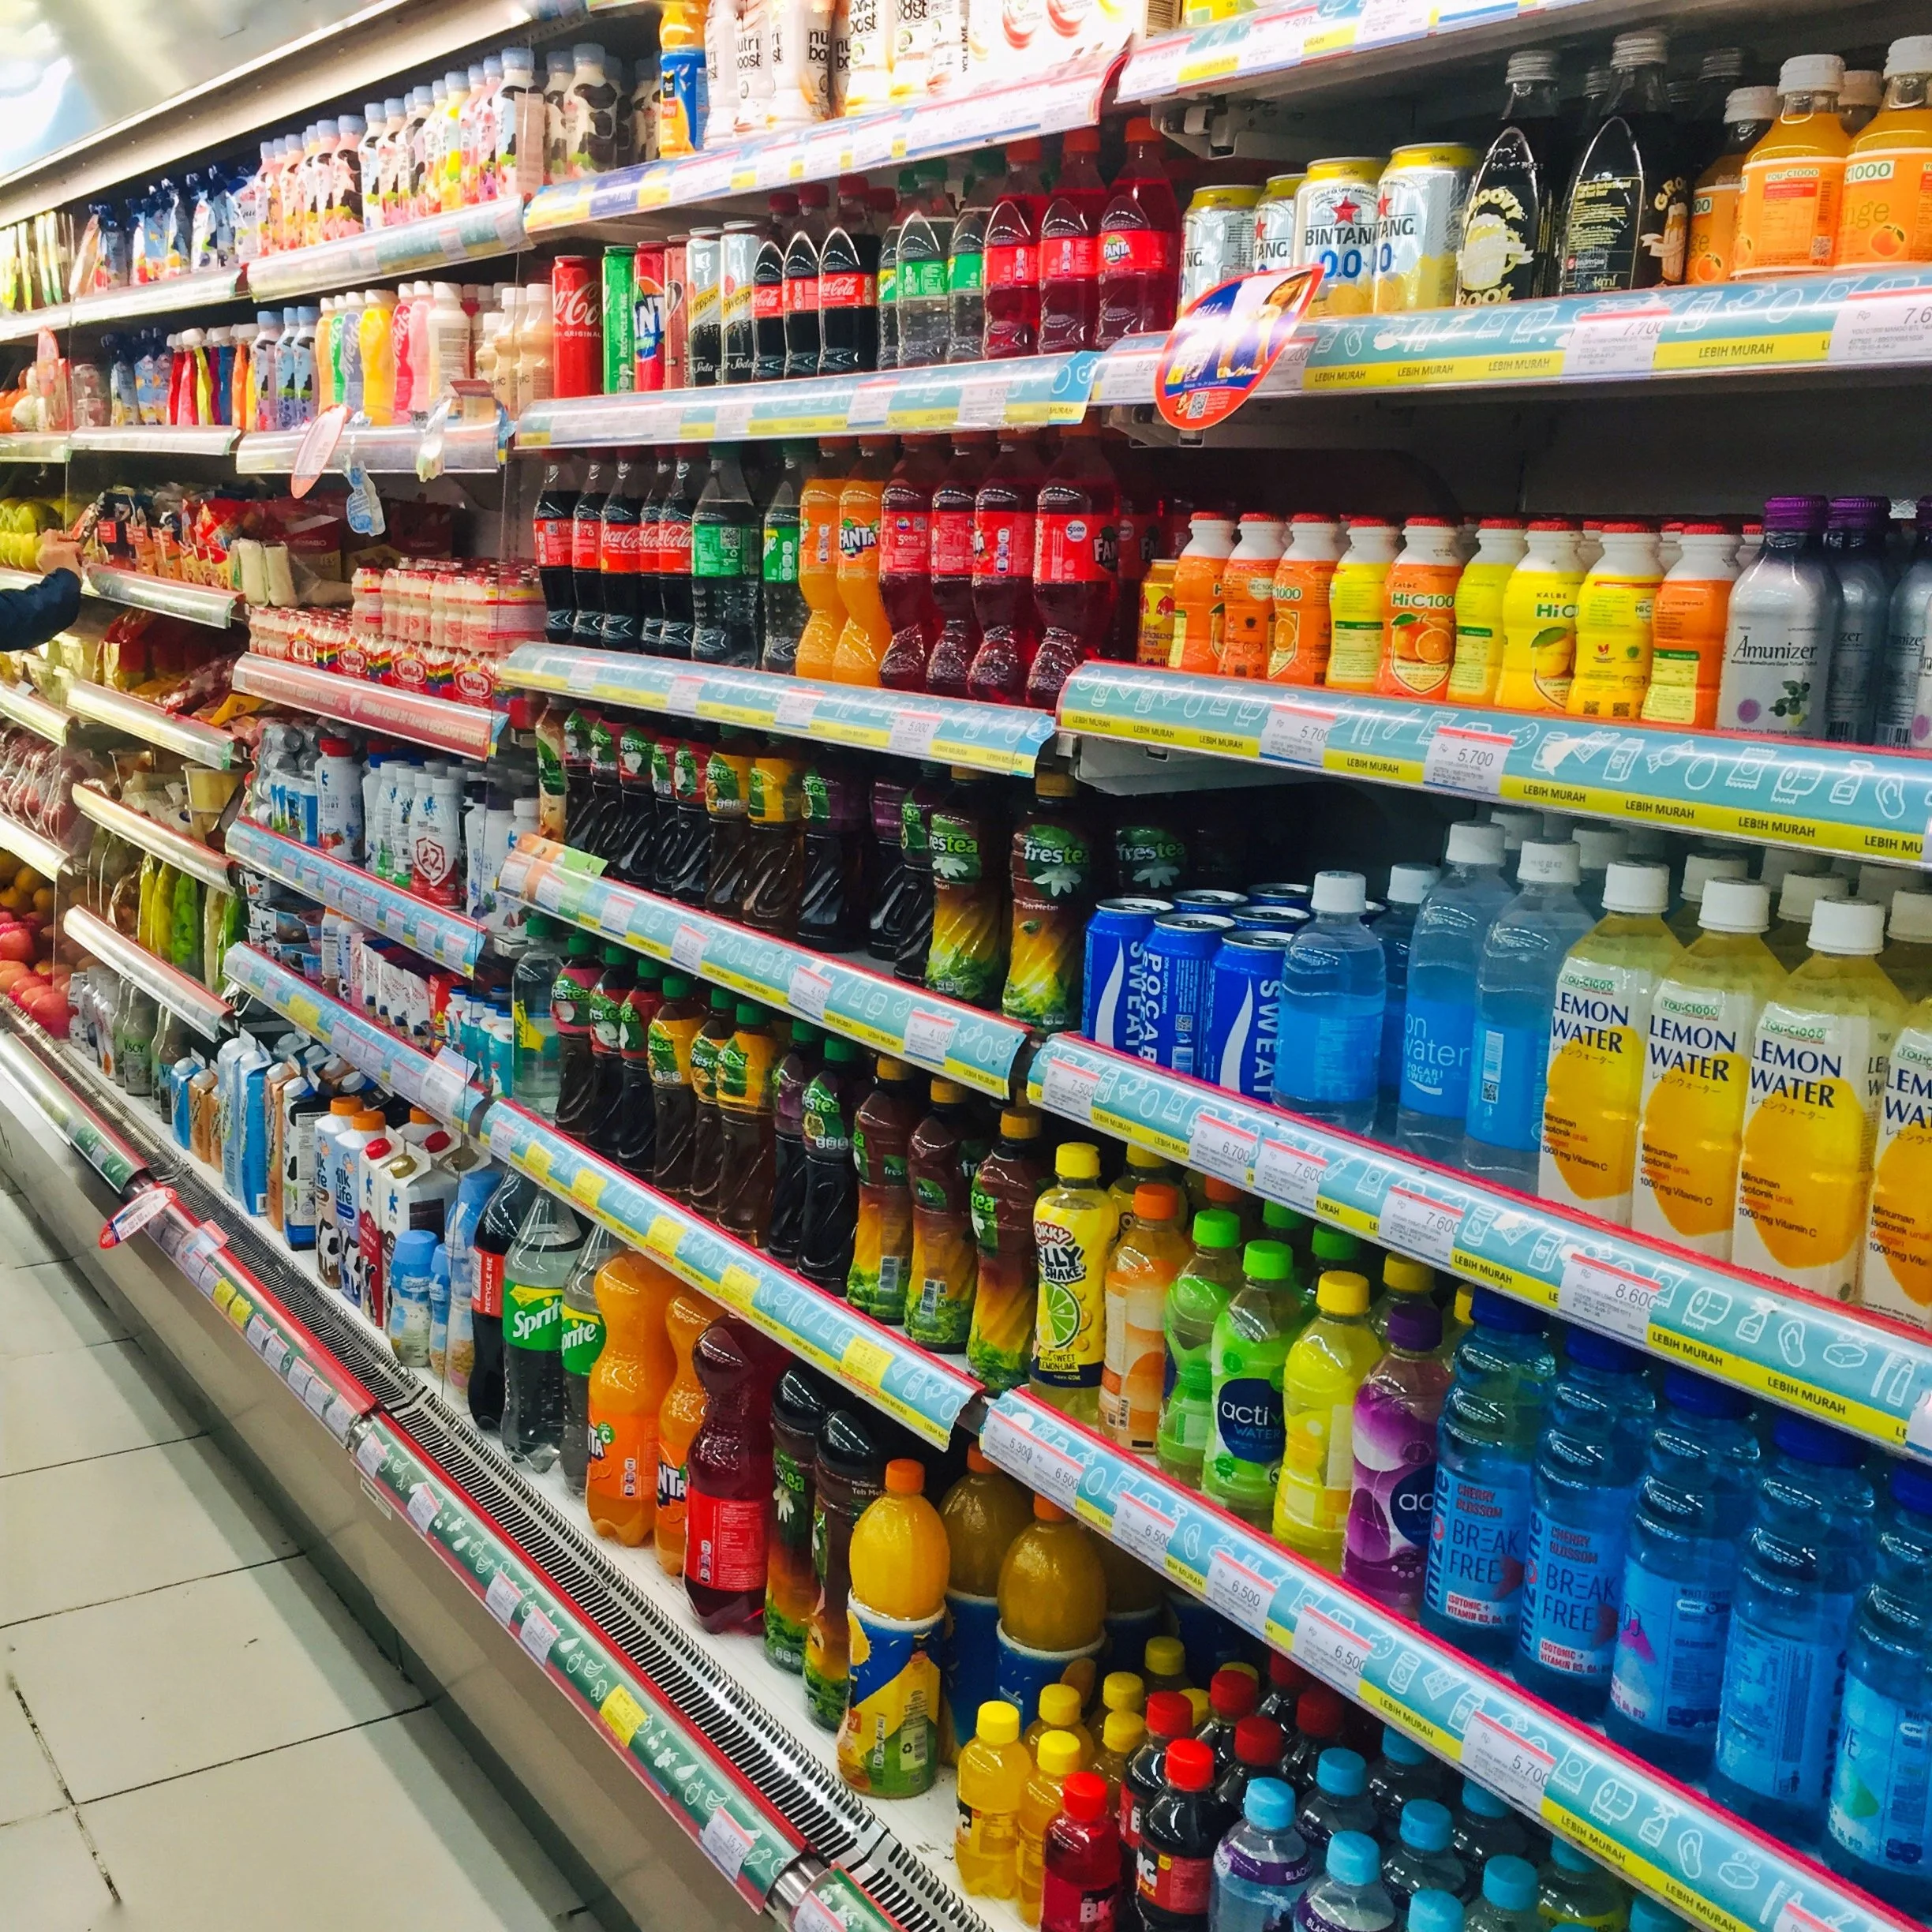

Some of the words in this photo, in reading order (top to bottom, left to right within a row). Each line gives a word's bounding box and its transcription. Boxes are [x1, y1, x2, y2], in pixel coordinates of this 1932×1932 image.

[1103, 241, 1131, 258] FANTA
[621, 293, 628, 312] ME
[1698, 346, 1730, 359] LEBIH
[1731, 343, 1774, 357] MURAH
[1397, 366, 1419, 377] LEBIH
[1420, 364, 1454, 376] MURAH
[1488, 361, 1511, 372] LEBIH
[1512, 358, 1550, 370] MURAH
[1313, 371, 1335, 383] LEBIH
[1337, 369, 1366, 381] MURAH
[839, 527, 877, 549] FANTA
[1733, 635, 1818, 660] Amunizer
[1072, 715, 1089, 726] LEBIH
[1090, 717, 1111, 729] MURAH
[1133, 724, 1151, 735] LEBIH
[1151, 727, 1174, 738] MURAH
[1199, 736, 1217, 745] LEBIH
[1218, 738, 1243, 749] MURAH
[1347, 758, 1368, 769] LEBIH
[1369, 761, 1399, 774] MURAH
[1458, 748, 1494, 767] 5.700
[1522, 784, 1548, 797] LEBIH
[1550, 788, 1586, 803] MURAH
[1625, 799, 1654, 814] LEBIH
[1654, 803, 1695, 819] MURAH
[1738, 816, 1769, 830] LEBIH
[1772, 821, 1815, 838] MURAH
[1024, 839, 1089, 864] frestea
[1117, 842, 1185, 862] frestea
[1864, 835, 1899, 851] LEBIH
[1253, 979, 1282, 1096] SWEAT
[1552, 1016, 1623, 1054] WATER
[1649, 1015, 1736, 1053] LEMON
[1649, 1043, 1729, 1082] WATER
[1751, 1038, 1842, 1079] LEMON
[1407, 1061, 1443, 1078] POCARI
[1407, 1070, 1439, 1085] SWEAT
[1751, 1066, 1835, 1109] WATER
[1093, 1112, 1110, 1126] LEBIH
[1110, 1118, 1133, 1134] MURAH
[1154, 1136, 1170, 1148] LEBIH
[1222, 1140, 1250, 1163] 6.700
[1642, 1143, 1678, 1160] Minuman
[1541, 1144, 1559, 1156] 1000
[1559, 1150, 1571, 1162] mg
[1572, 1153, 1600, 1170] Vitamin
[1601, 1163, 1608, 1171] C
[1642, 1154, 1672, 1170] Isotonik
[1741, 1170, 1780, 1190] Minuman
[1640, 1178, 1658, 1188] 1000
[1659, 1184, 1672, 1196] mg
[1673, 1187, 1702, 1204] Vitamin
[1705, 1197, 1713, 1206] C
[1739, 1183, 1773, 1200] Isotonik
[1775, 1193, 1795, 1206] unik
[1738, 1207, 1758, 1221] 1000
[1759, 1214, 1773, 1226] mg
[1774, 1216, 1809, 1237] Vitamin
[1810, 1227, 1818, 1238] C
[1872, 1204, 1915, 1225] Minuman
[1870, 1216, 1908, 1236] Isotonik
[1868, 1241, 1891, 1256] 1000
[1892, 1249, 1908, 1262] mg
[487, 1256, 493, 1272] ME
[1045, 1268, 1082, 1281] SHAKE
[1454, 1254, 1478, 1272] LEBIH
[1479, 1263, 1513, 1285] MURAH
[513, 1297, 563, 1340] Sprit
[1652, 1331, 1681, 1351] LEBIH
[1683, 1341, 1724, 1367] MURAH
[1767, 1376, 1799, 1398] LEBIH
[1801, 1388, 1846, 1415] MURAH
[1234, 1424, 1281, 1440] WATER
[1451, 1518, 1521, 1555] BREAK
[1178, 1566, 1203, 1588] MURAH
[1449, 1549, 1500, 1585] FREE
[1231, 1579, 1261, 1607] 6.500
[1546, 1563, 1617, 1602] BREAK
[1447, 1593, 1482, 1612] ISOTONIC
[1447, 1604, 1477, 1621] VITAMIN
[1543, 1594, 1595, 1633] FREE
[1541, 1638, 1576, 1660] ISOTONIC
[1541, 1651, 1571, 1669] VITAMIN
[1379, 1696, 1402, 1719] LEBIH
[1402, 1712, 1435, 1739] MURAH
[1561, 1814, 1587, 1837] LEBIH
[1589, 1832, 1627, 1863] MURAH
[1665, 1881, 1694, 1907] LEBIH
[1696, 1900, 1736, 1932] MURAH
